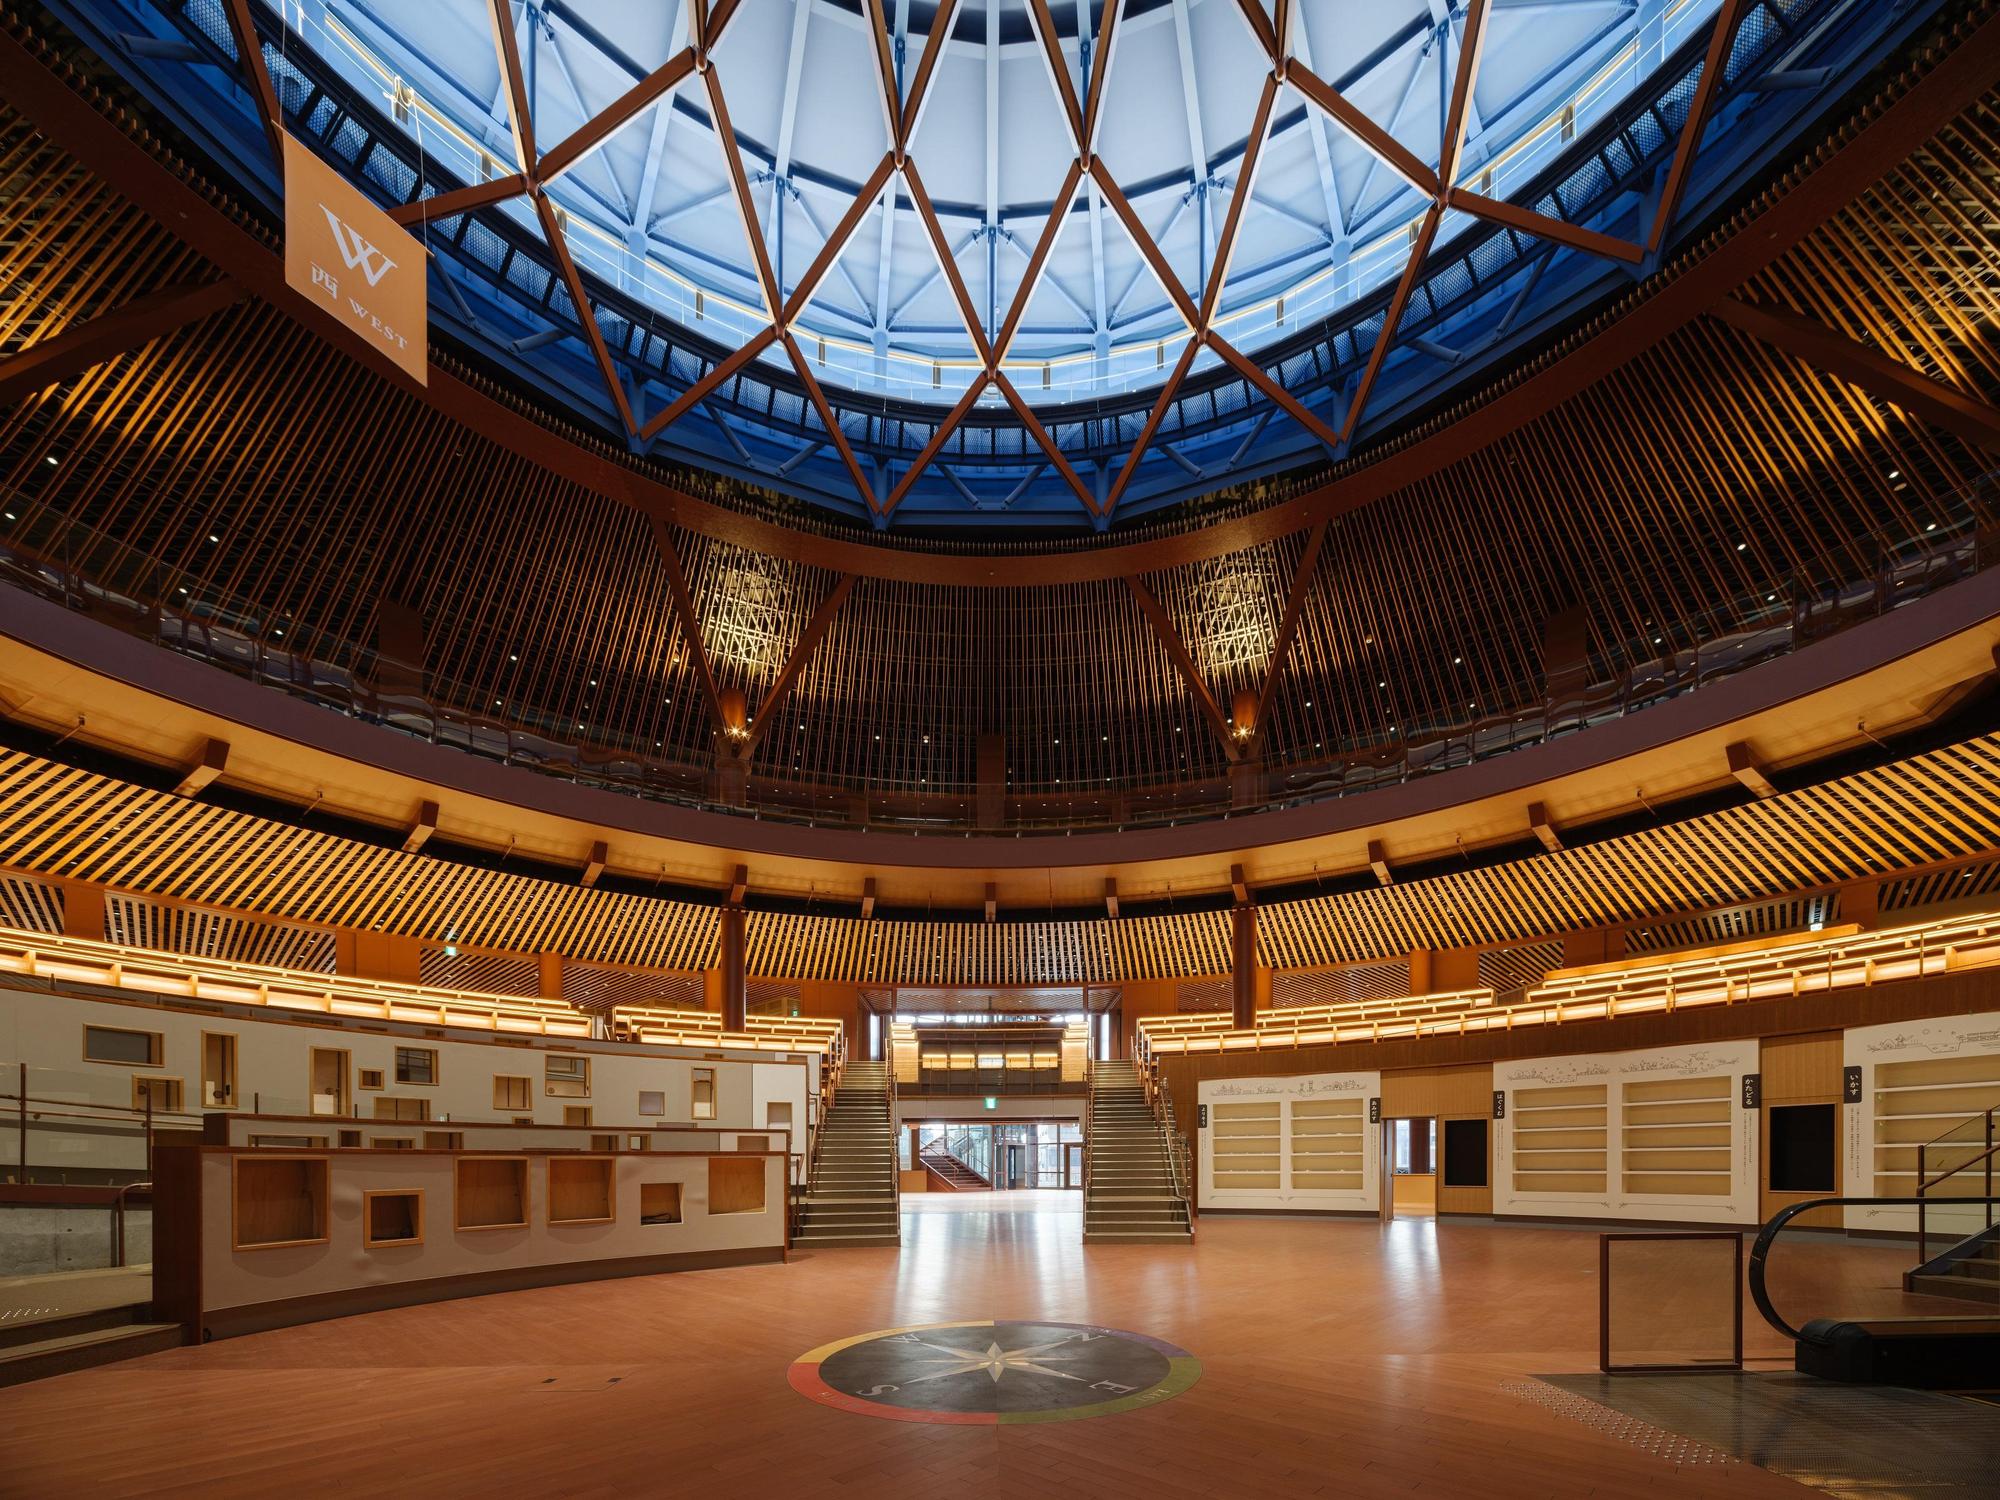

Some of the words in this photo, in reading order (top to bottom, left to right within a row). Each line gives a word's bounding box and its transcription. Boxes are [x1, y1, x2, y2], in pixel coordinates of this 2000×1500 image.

[319, 203, 398, 287] W
[311, 261, 339, 299] 西
[348, 296, 408, 349] WEST
[1745, 1078, 1753, 1105] かたどる
[1850, 1074, 1859, 1096] いかす
[881, 1333, 920, 1343] W
[1064, 1332, 1107, 1342] N
[856, 1384, 899, 1396] S
[1089, 1380, 1138, 1394] E
